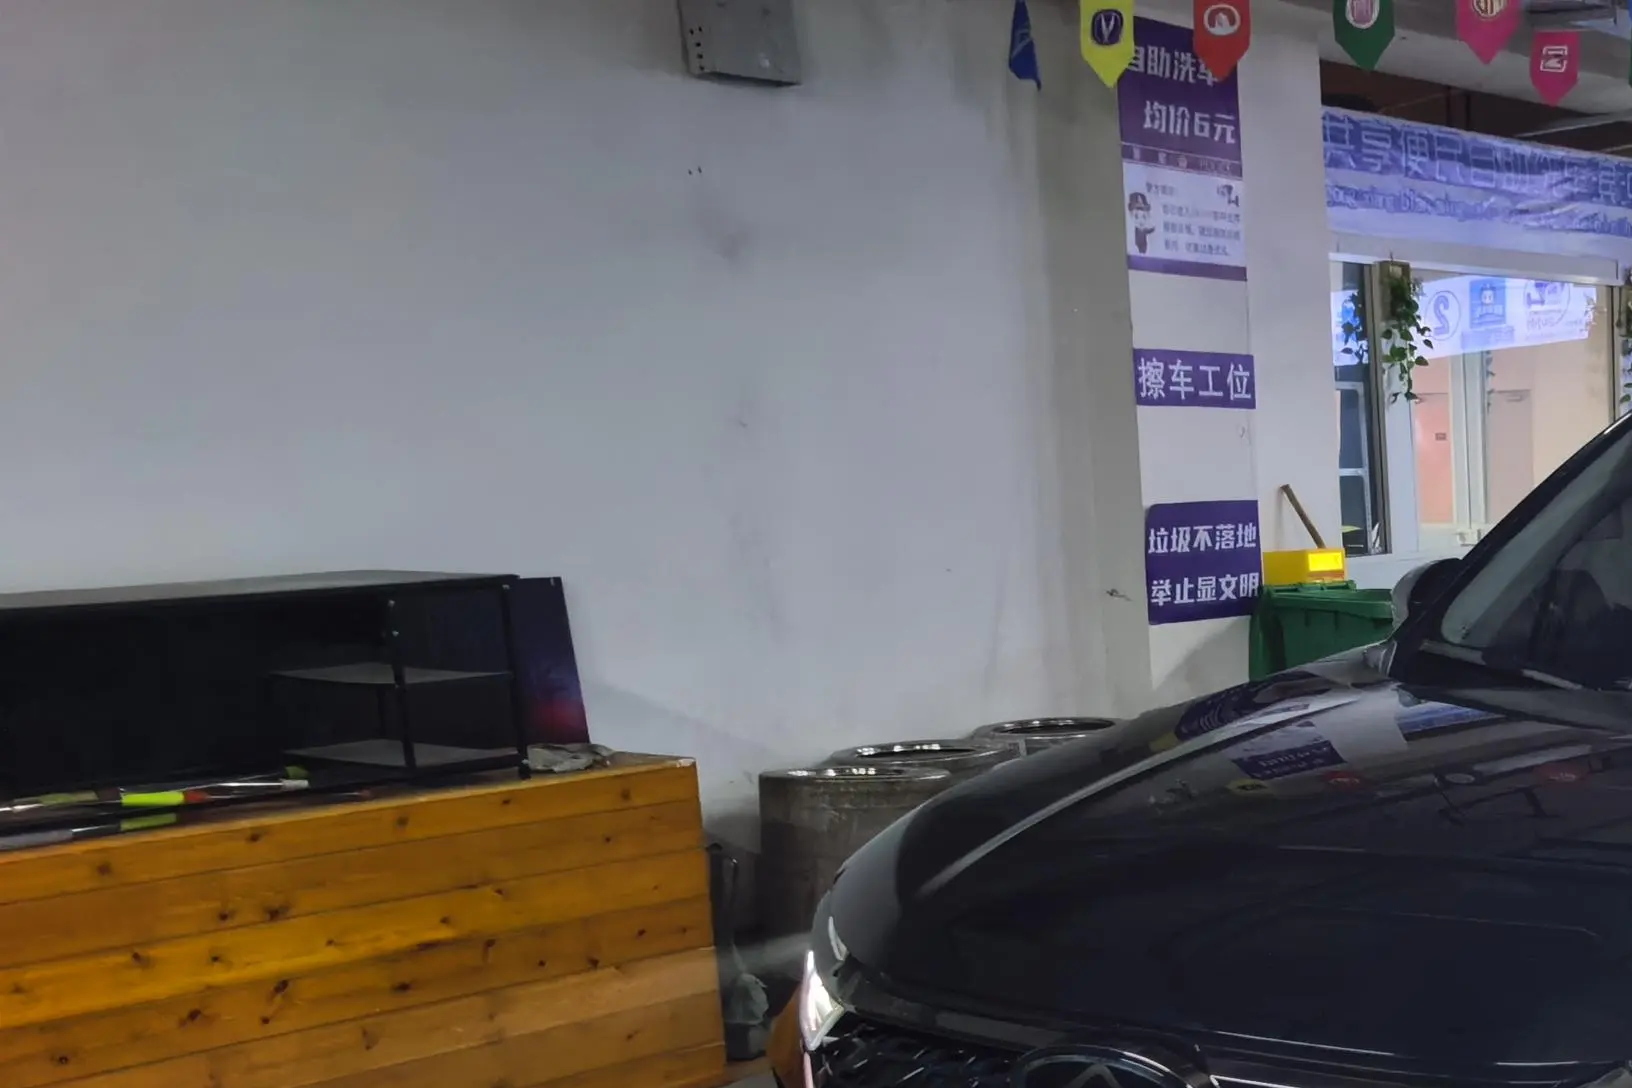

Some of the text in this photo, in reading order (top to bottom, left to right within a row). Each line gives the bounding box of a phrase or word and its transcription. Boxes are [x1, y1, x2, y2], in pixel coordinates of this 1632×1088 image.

[1143, 100, 1236, 144] 均价6元
[1138, 357, 1252, 400] 擦车工位
[1148, 523, 1257, 554] 垃圾不落地
[1151, 573, 1260, 606] 举止显文明
